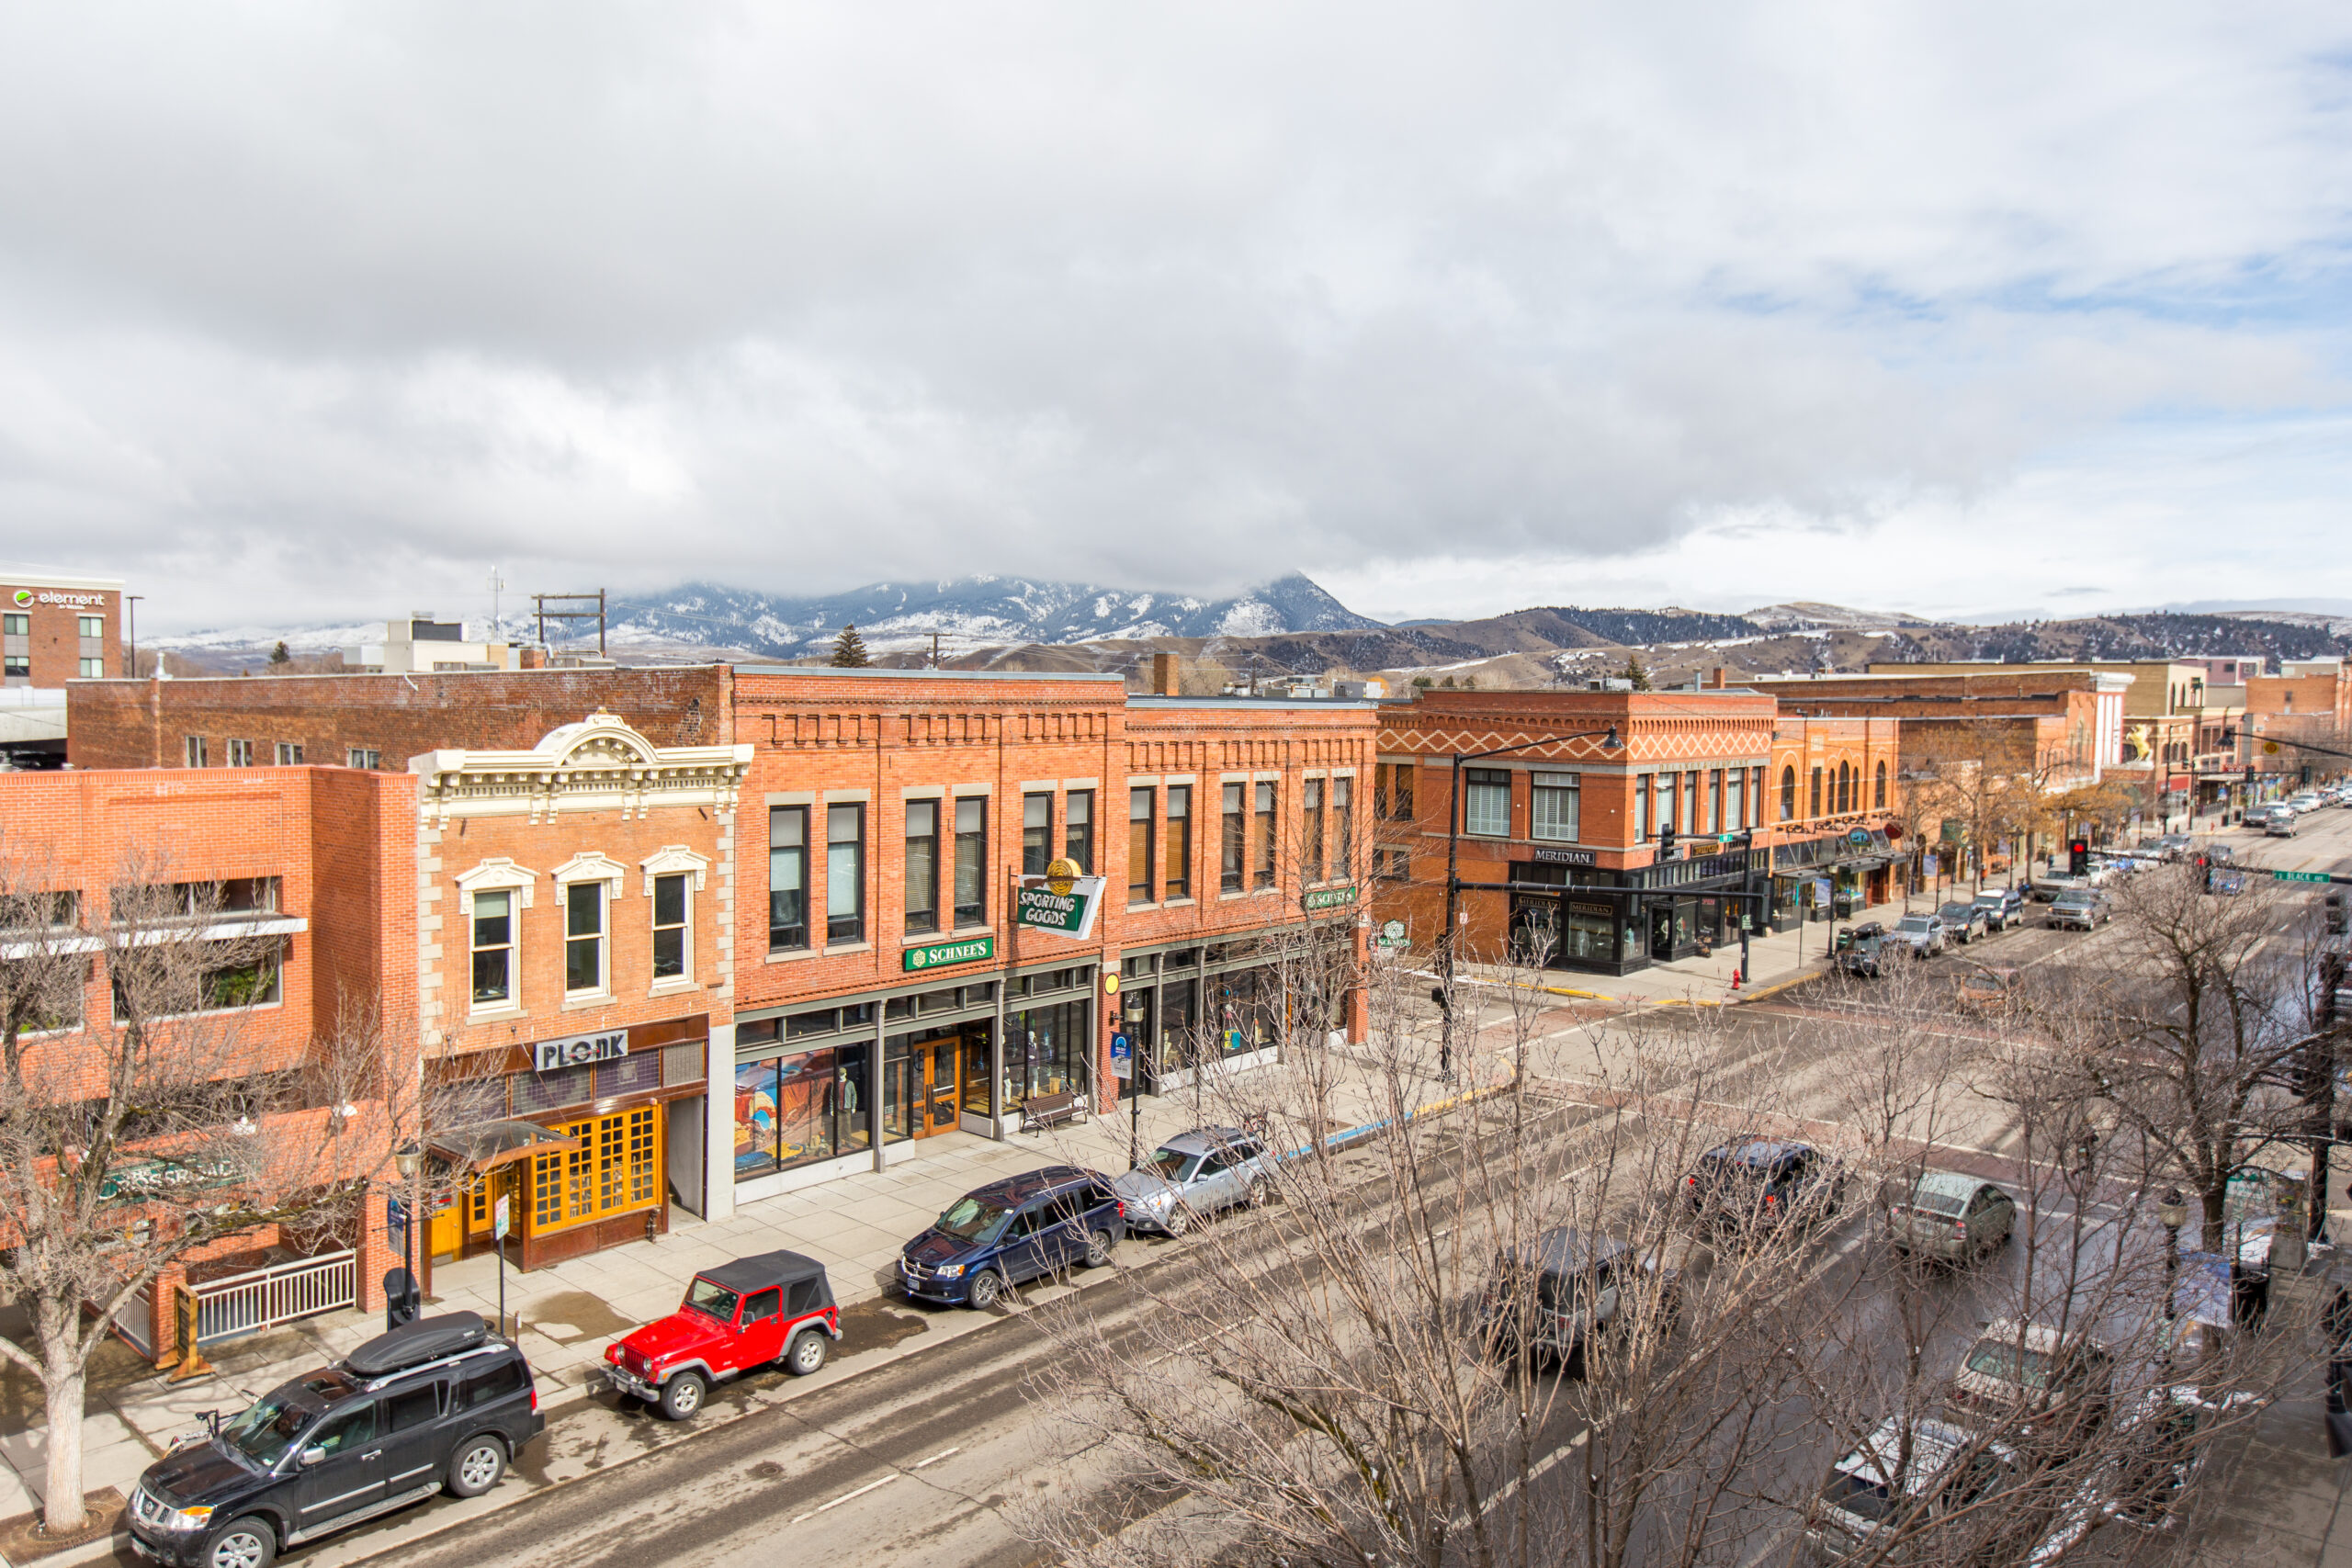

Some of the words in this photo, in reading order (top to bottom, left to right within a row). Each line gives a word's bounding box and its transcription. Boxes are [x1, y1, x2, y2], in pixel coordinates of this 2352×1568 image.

[39, 591, 106, 606] element
[1536, 850, 1590, 863] MERIDIAN
[2286, 872, 2310, 881] BLACK
[1019, 892, 1076, 912] SPORTING
[1025, 908, 1068, 926] GOODS
[929, 942, 987, 964] SCHNEE'S
